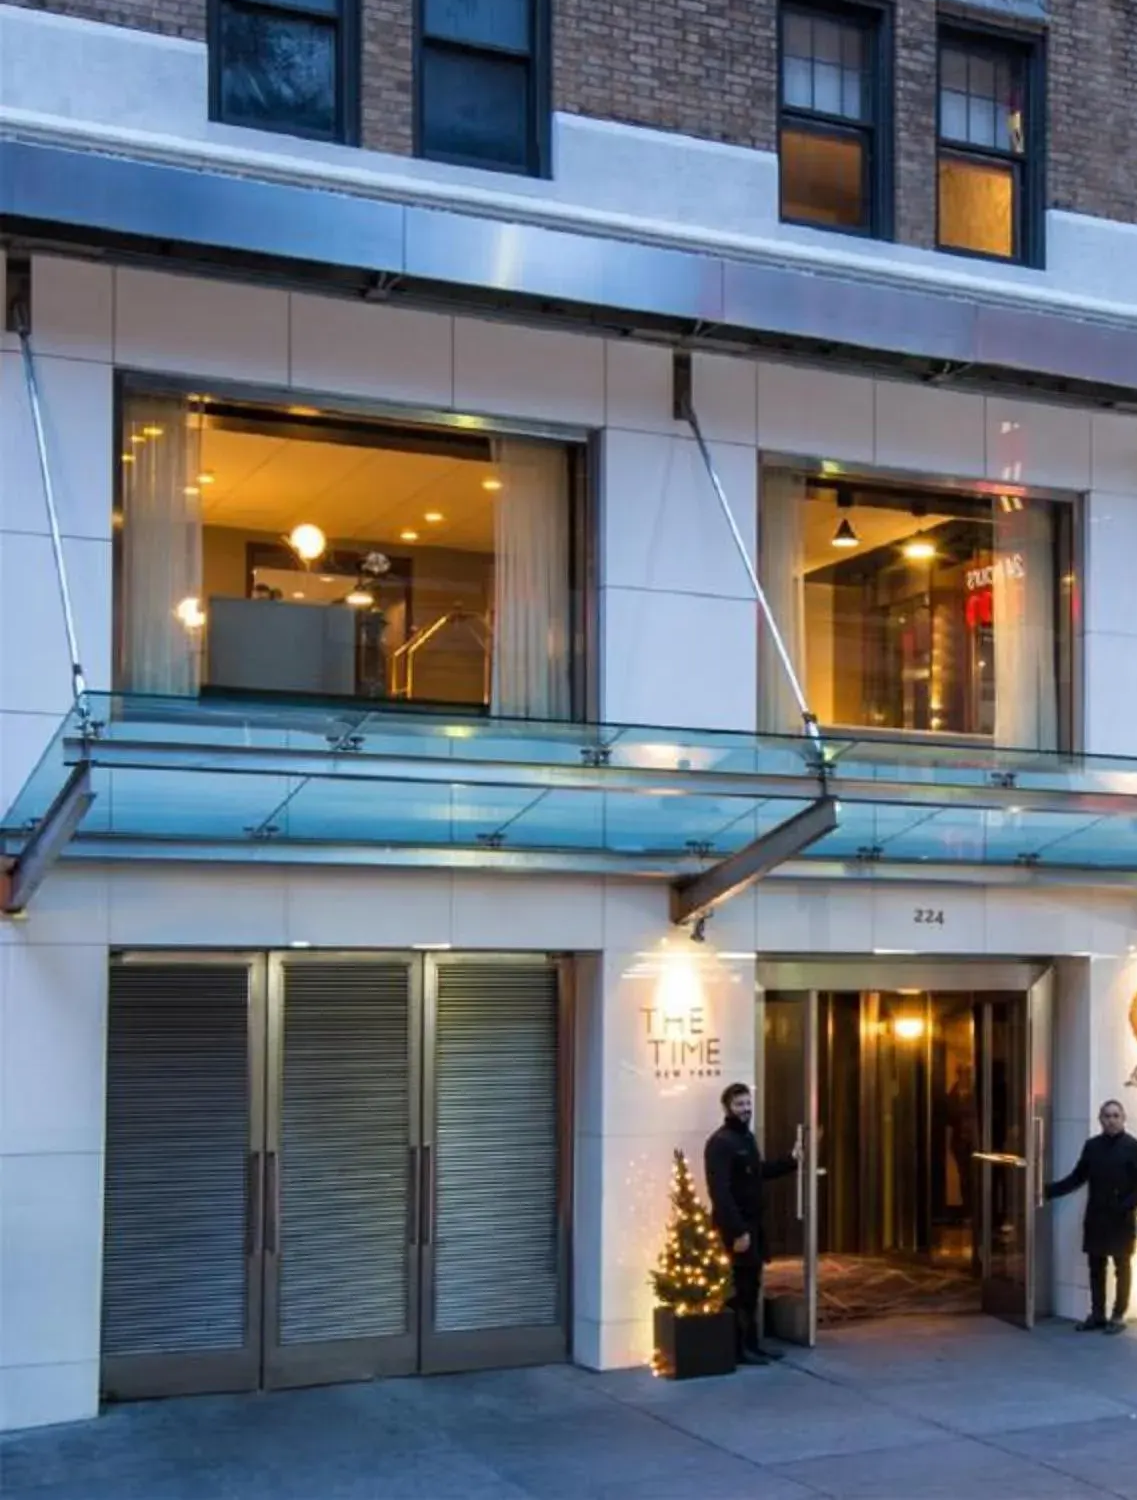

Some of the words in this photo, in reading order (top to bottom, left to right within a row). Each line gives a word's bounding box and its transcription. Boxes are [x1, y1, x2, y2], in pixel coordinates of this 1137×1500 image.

[913, 908, 945, 925] 224
[639, 1007, 704, 1035] THE
[647, 1038, 721, 1066] TIME
